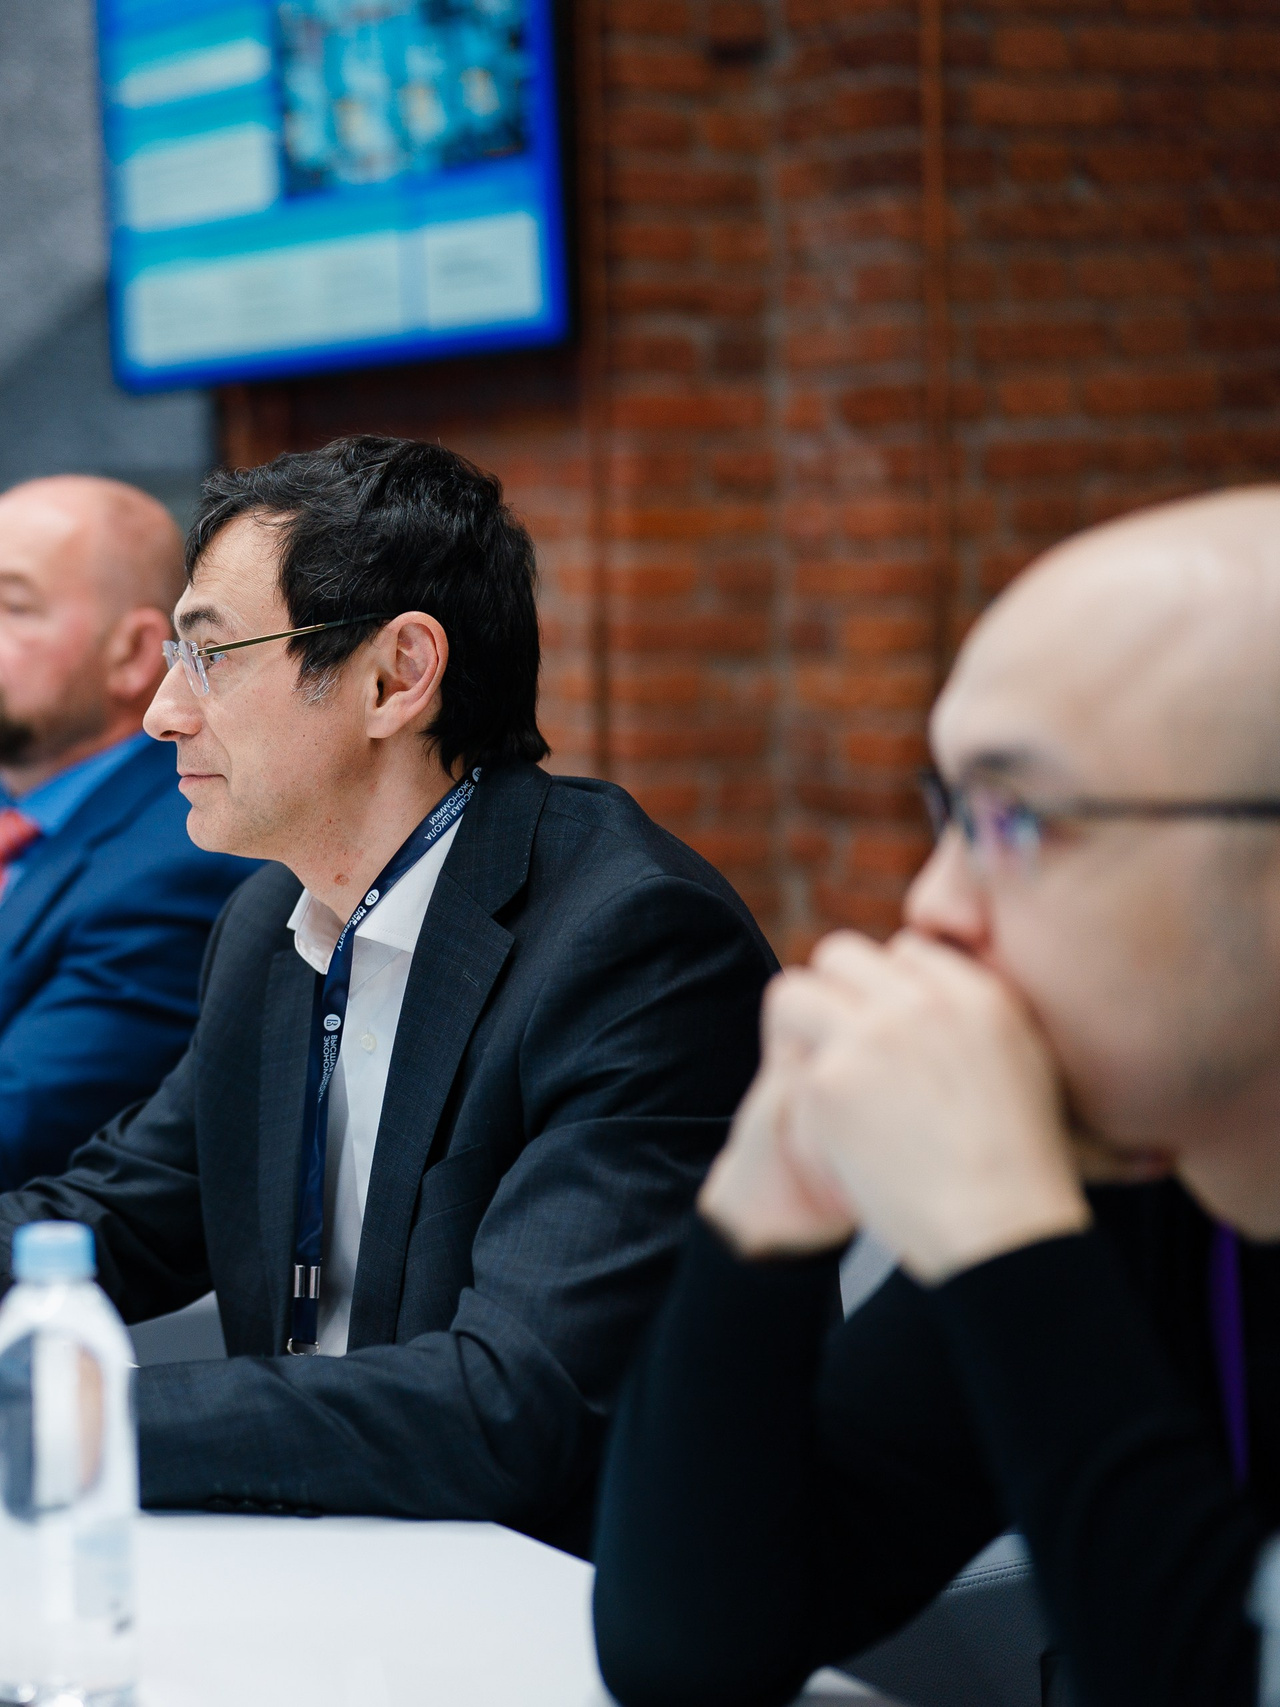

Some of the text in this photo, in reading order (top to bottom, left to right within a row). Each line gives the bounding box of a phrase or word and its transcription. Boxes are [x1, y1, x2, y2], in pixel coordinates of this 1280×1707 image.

[428, 779, 472, 826] ЭКОНОМИКИ
[424, 813, 453, 841] ШКОЛА
[336, 905, 364, 952] UNIVERSITY
[329, 1034, 339, 1073] ВЫСШАЯ
